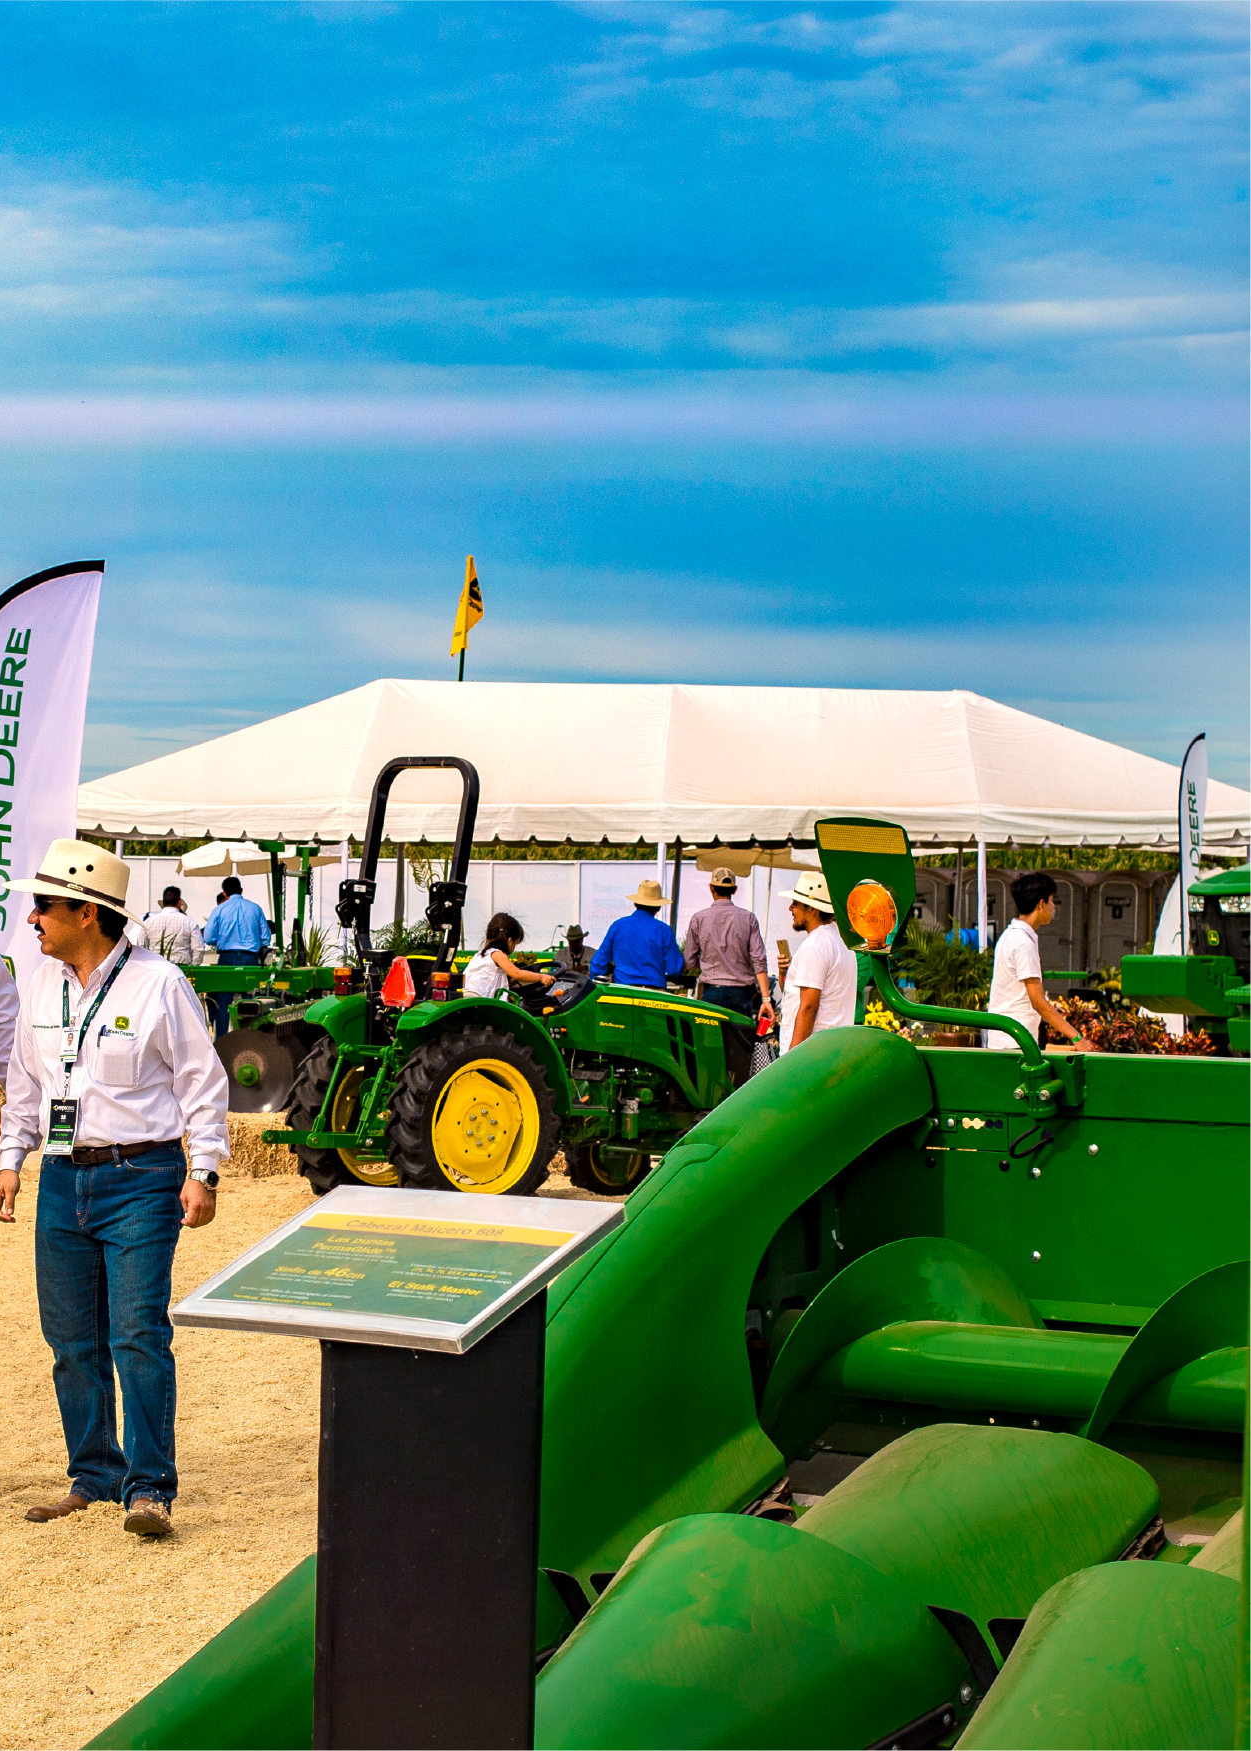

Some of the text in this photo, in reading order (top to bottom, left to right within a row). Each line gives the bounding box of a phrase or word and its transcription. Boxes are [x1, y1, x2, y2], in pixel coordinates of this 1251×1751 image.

[1186, 779, 1200, 868] DEERE
[652, 1001, 670, 1009] DEERE
[346, 1219, 505, 1237] Cabezal Maicero 608
[327, 1235, 396, 1246] Las puntas
[387, 1280, 405, 1289] El
[405, 1282, 437, 1292] Stalk
[438, 1285, 484, 1296] Master
